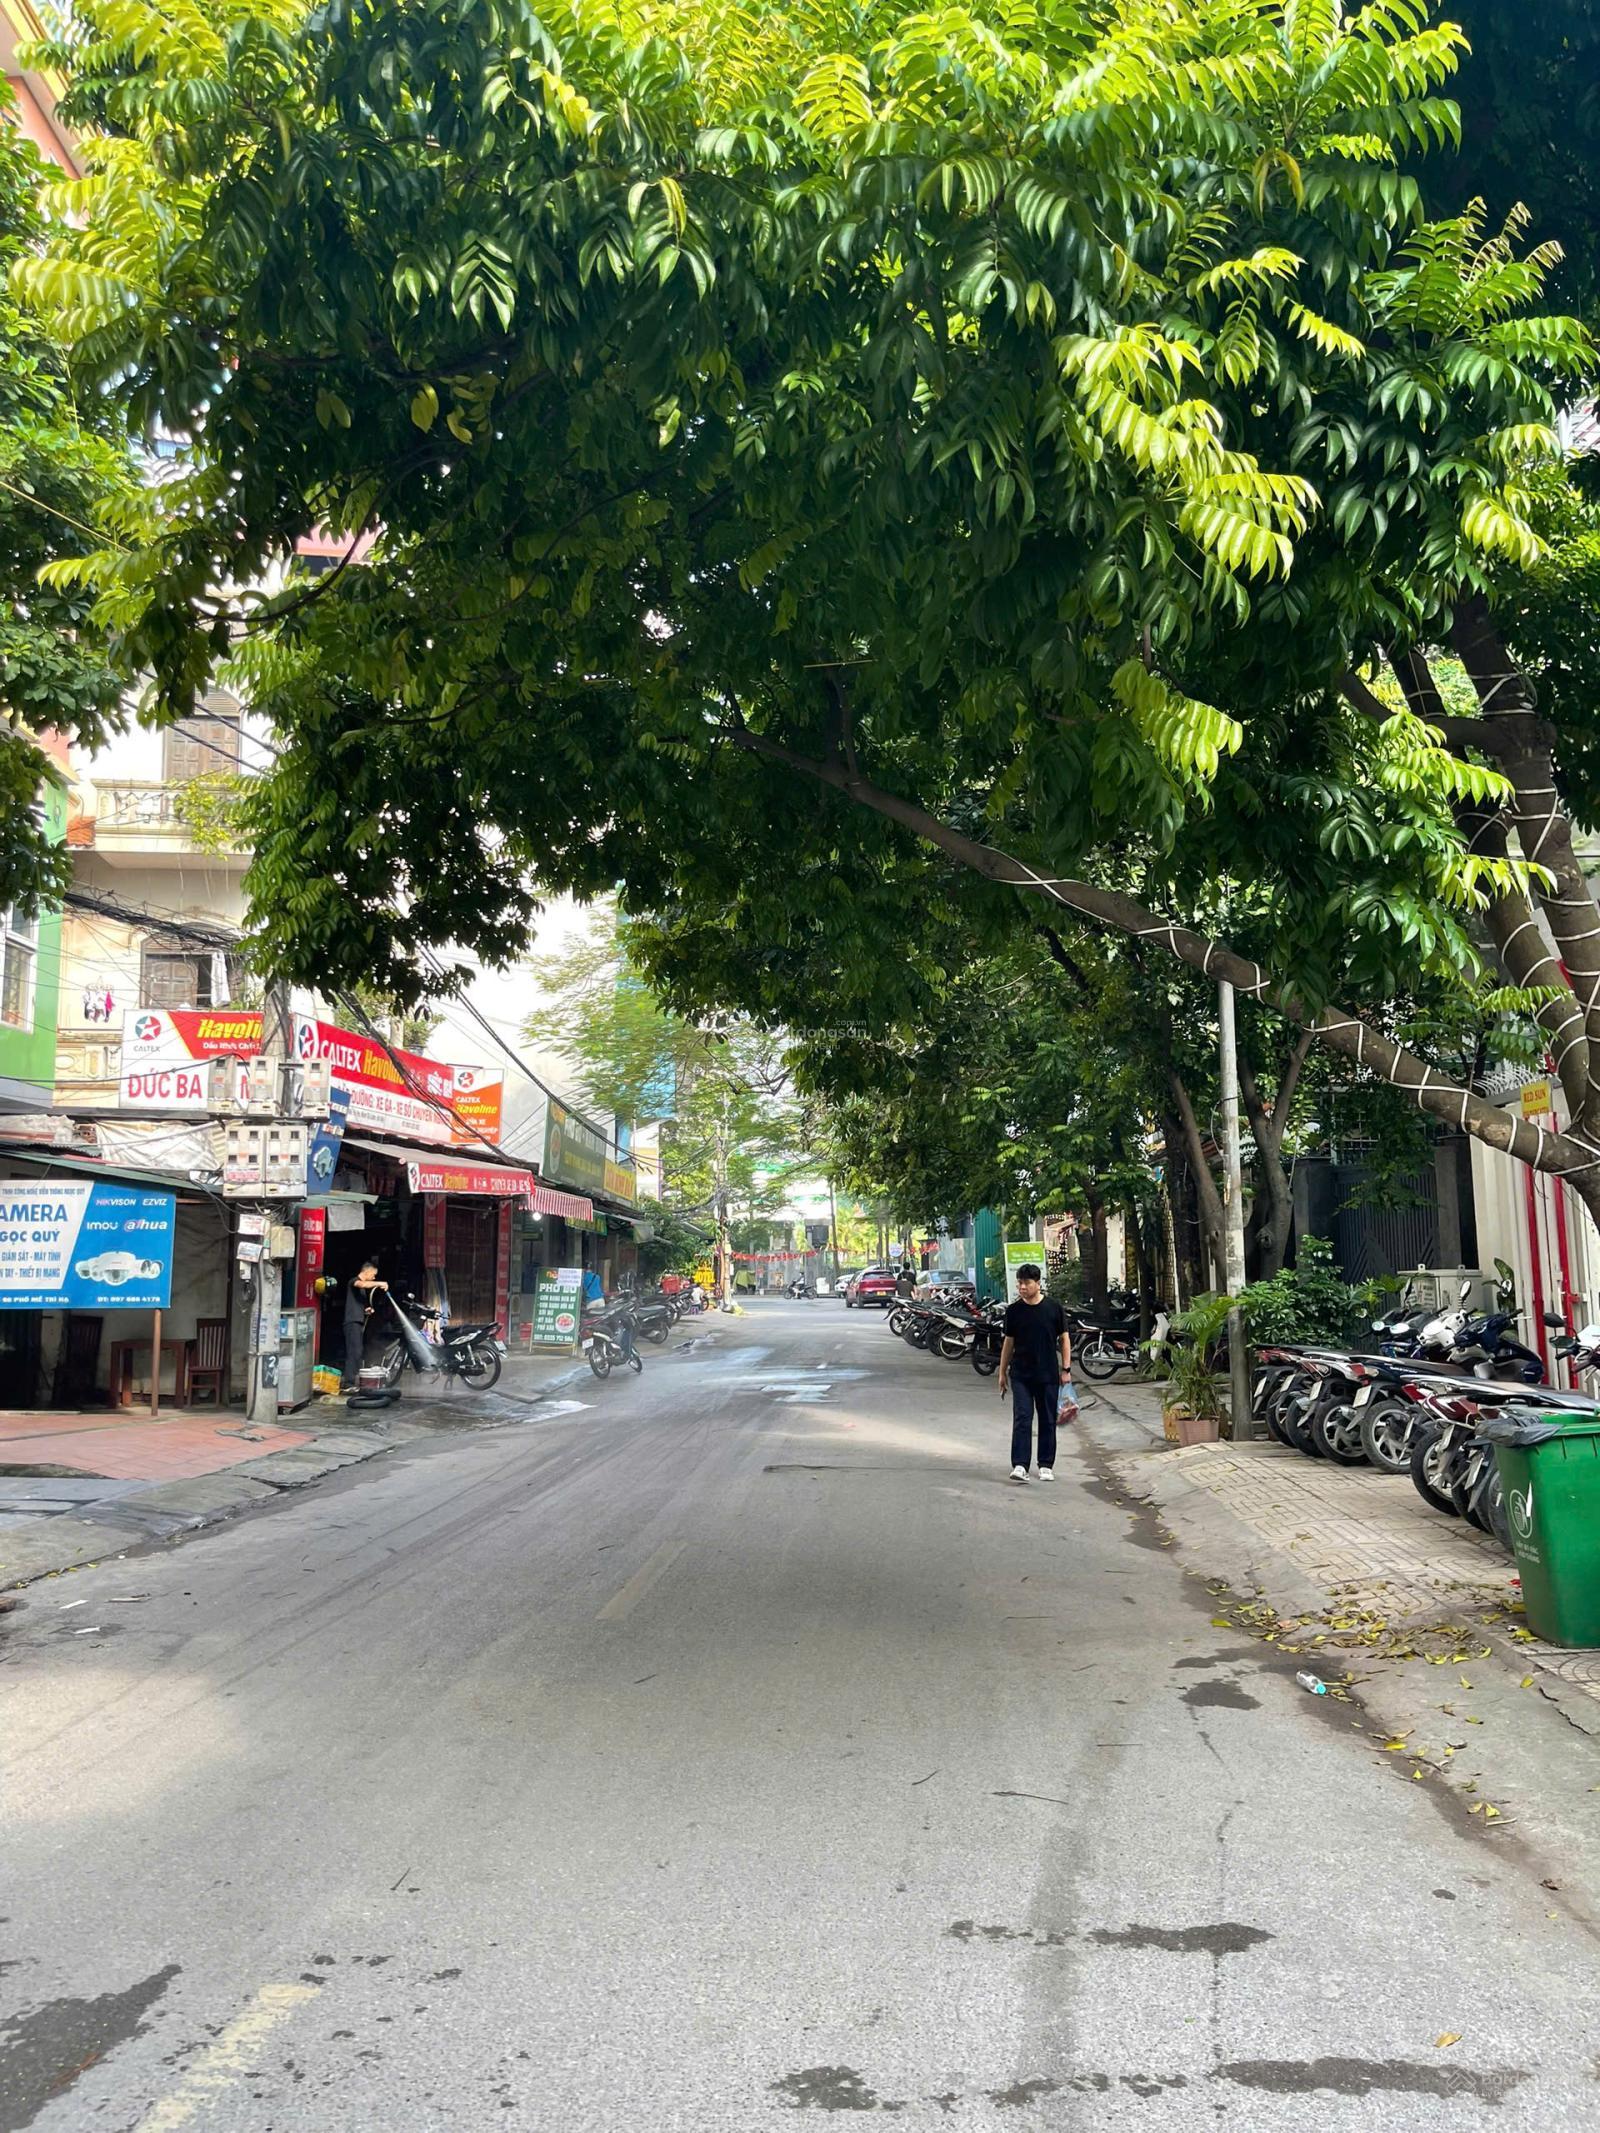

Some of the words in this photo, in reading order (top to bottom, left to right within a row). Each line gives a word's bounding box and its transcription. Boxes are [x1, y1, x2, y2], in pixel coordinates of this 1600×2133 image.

[320, 1039, 362, 1073] CALTEX
[128, 1067, 170, 1099] ĐỨC
[176, 1074, 202, 1099] BA
[142, 1198, 168, 1206] EZVIZ
